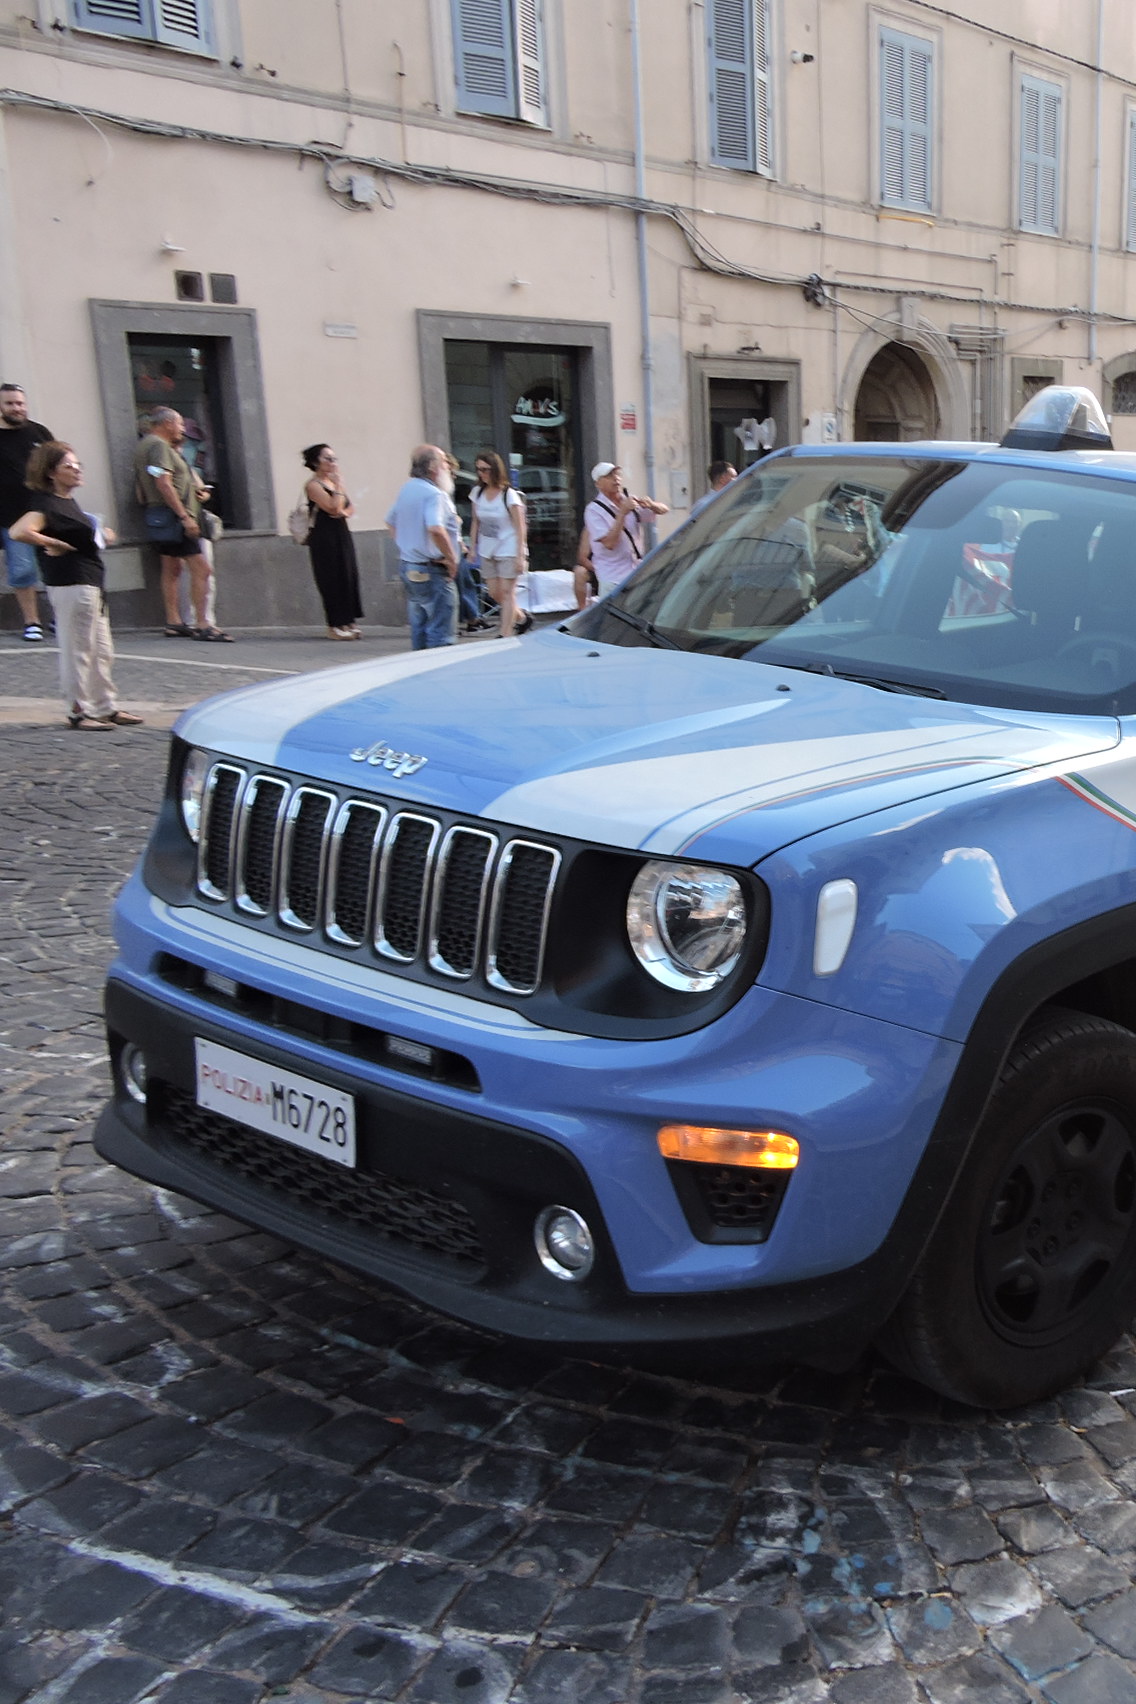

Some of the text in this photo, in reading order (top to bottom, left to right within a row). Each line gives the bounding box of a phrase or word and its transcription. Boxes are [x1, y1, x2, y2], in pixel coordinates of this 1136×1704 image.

[349, 740, 428, 778] Jeep
[201, 1064, 347, 1148] POLIZIA M6728
